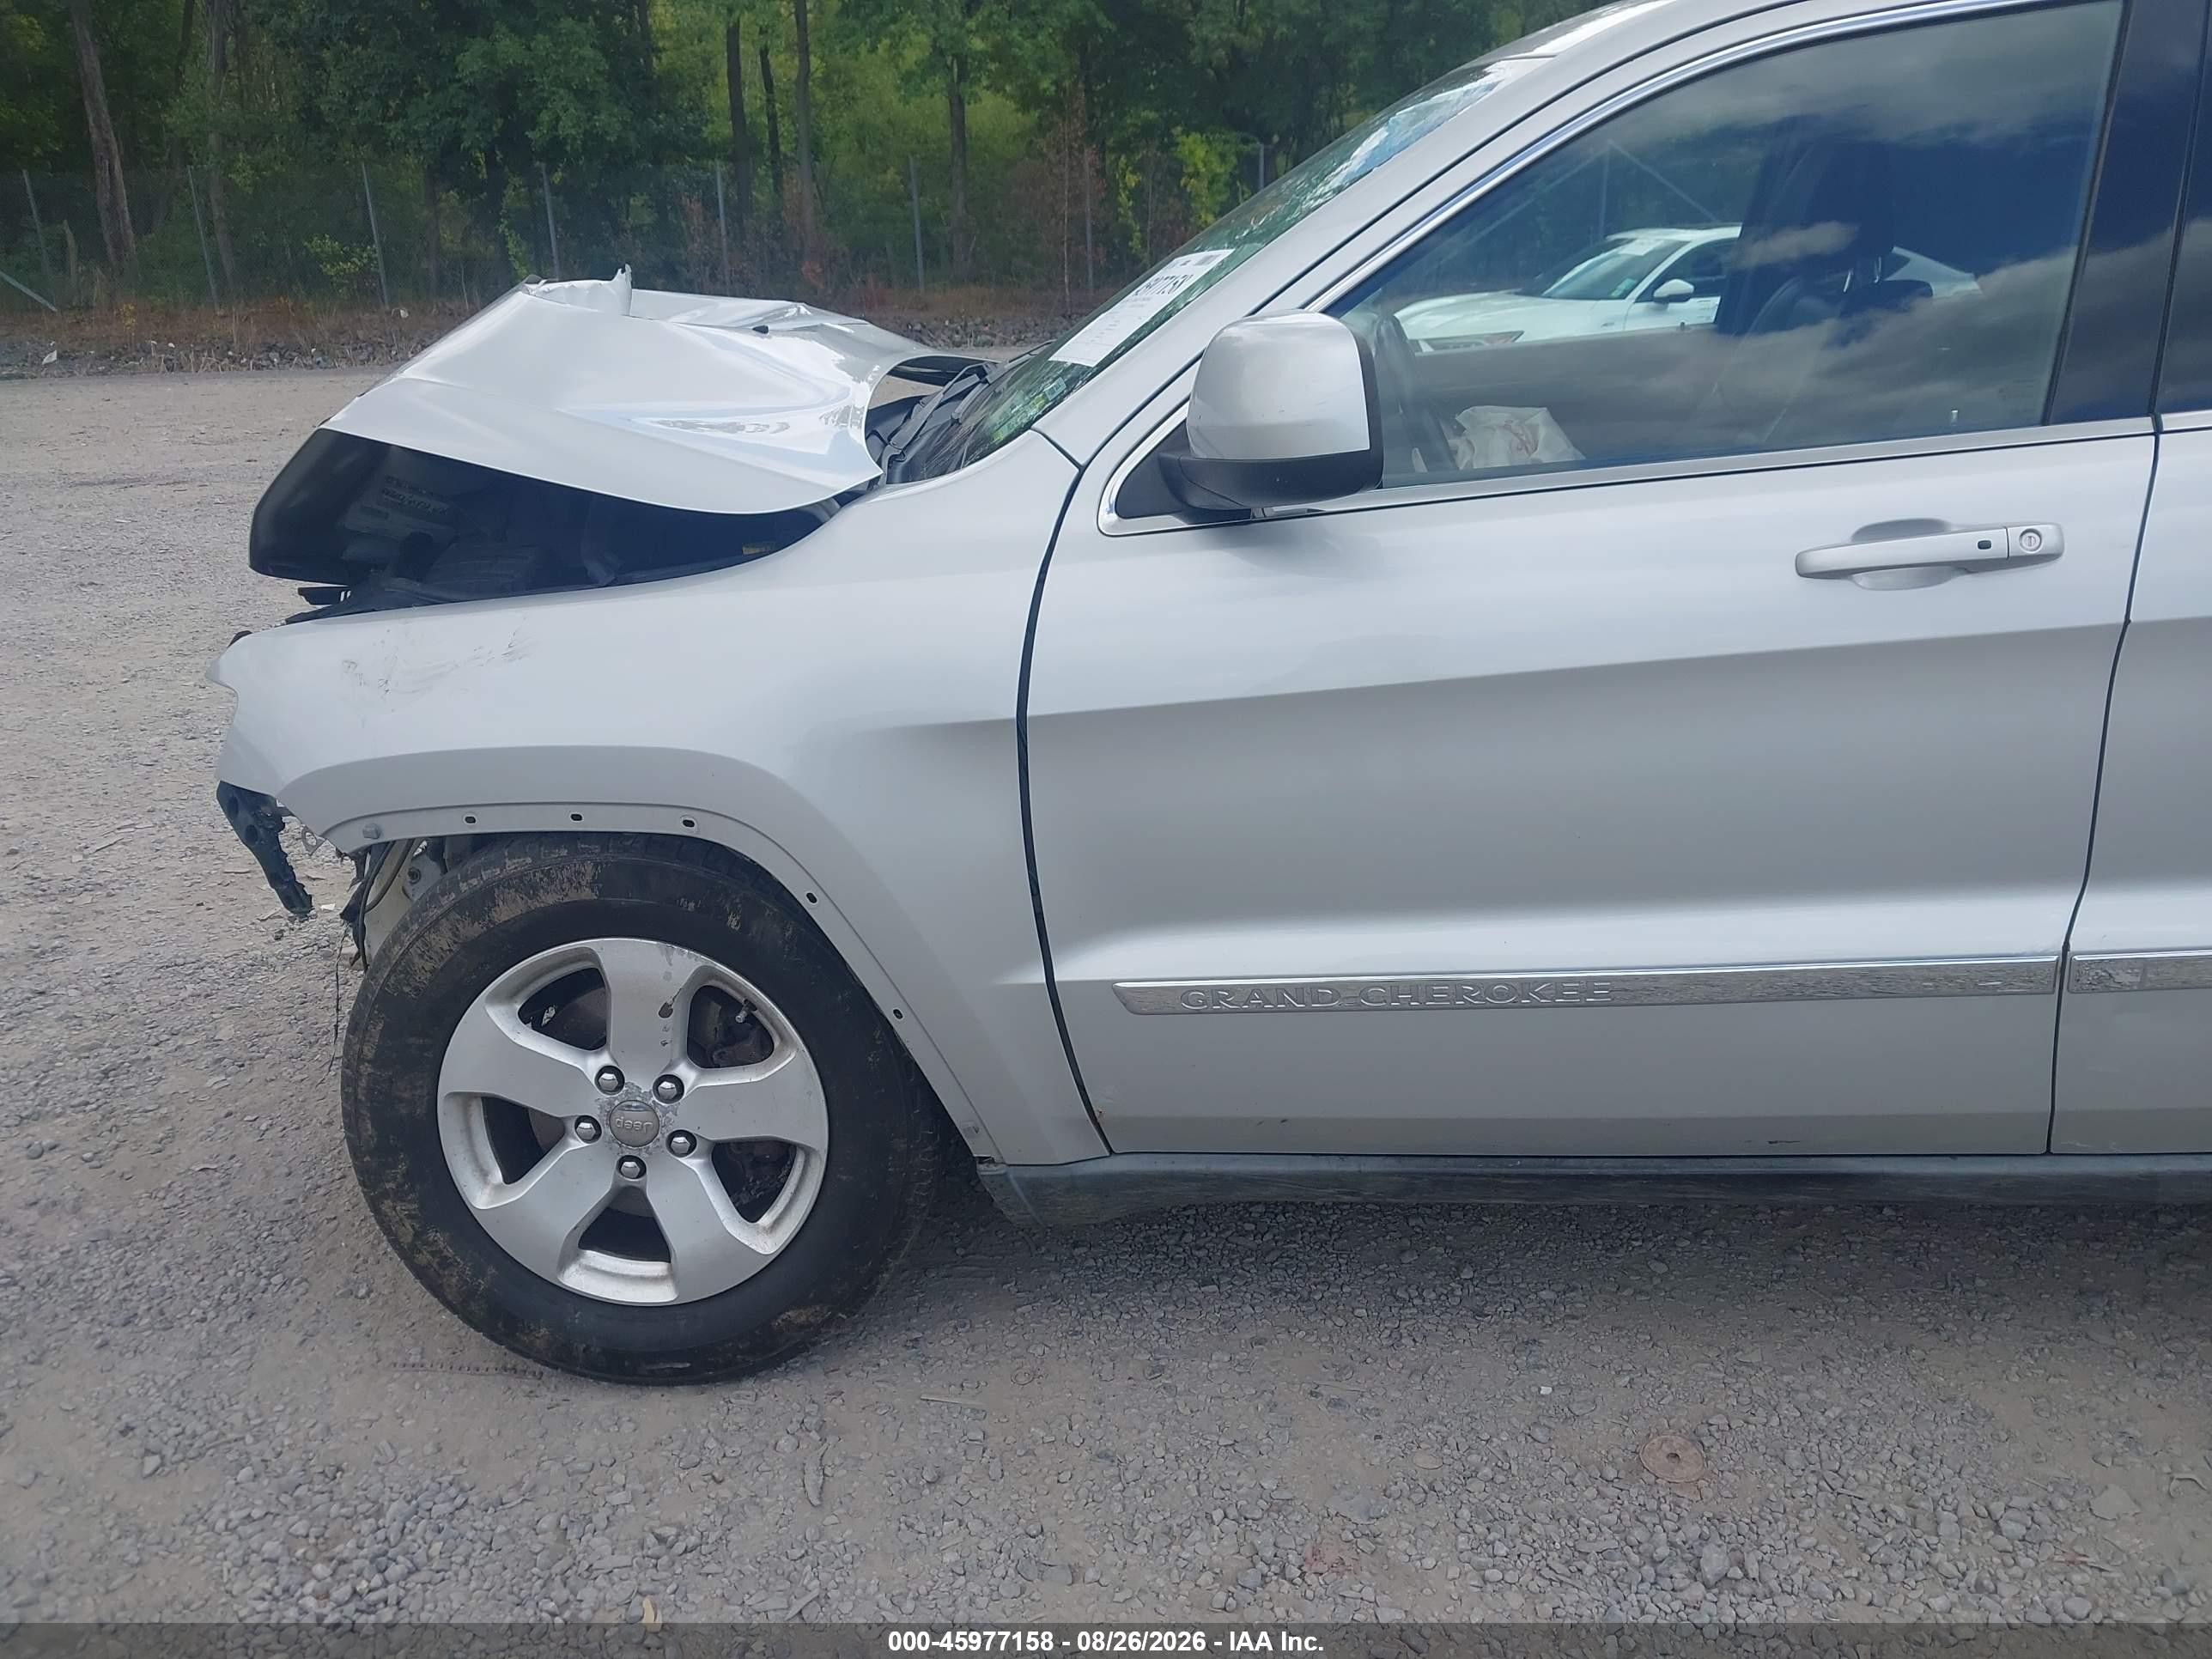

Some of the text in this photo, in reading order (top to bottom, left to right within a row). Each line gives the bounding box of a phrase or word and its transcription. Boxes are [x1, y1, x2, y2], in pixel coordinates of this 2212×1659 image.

[1181, 981, 1613, 1010] GRAND CHEROKEE
[615, 1115, 653, 1134] Jeep
